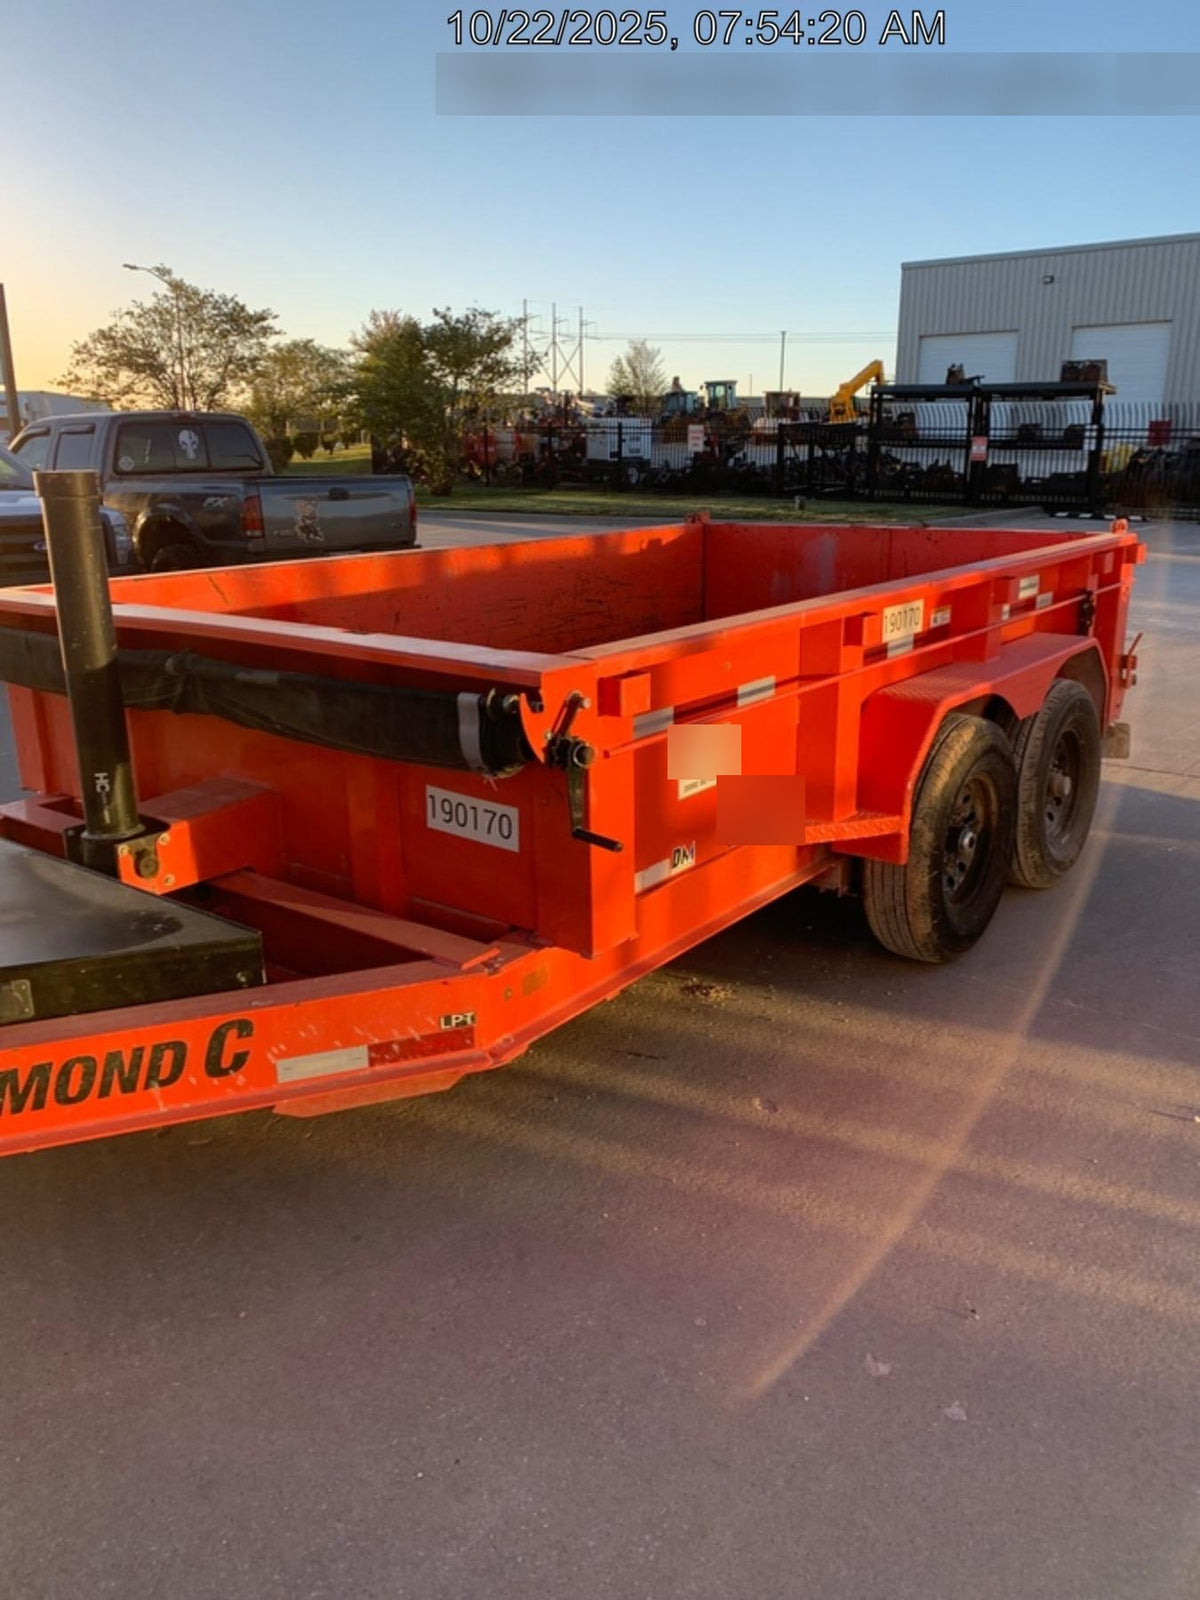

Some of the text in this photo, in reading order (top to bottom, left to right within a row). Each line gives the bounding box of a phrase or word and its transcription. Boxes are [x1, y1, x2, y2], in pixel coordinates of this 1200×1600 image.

[884, 606, 920, 634] 190170
[428, 794, 513, 840] 190170
[440, 1011, 475, 1030] LPT
[0, 1018, 254, 1116] MOND C
